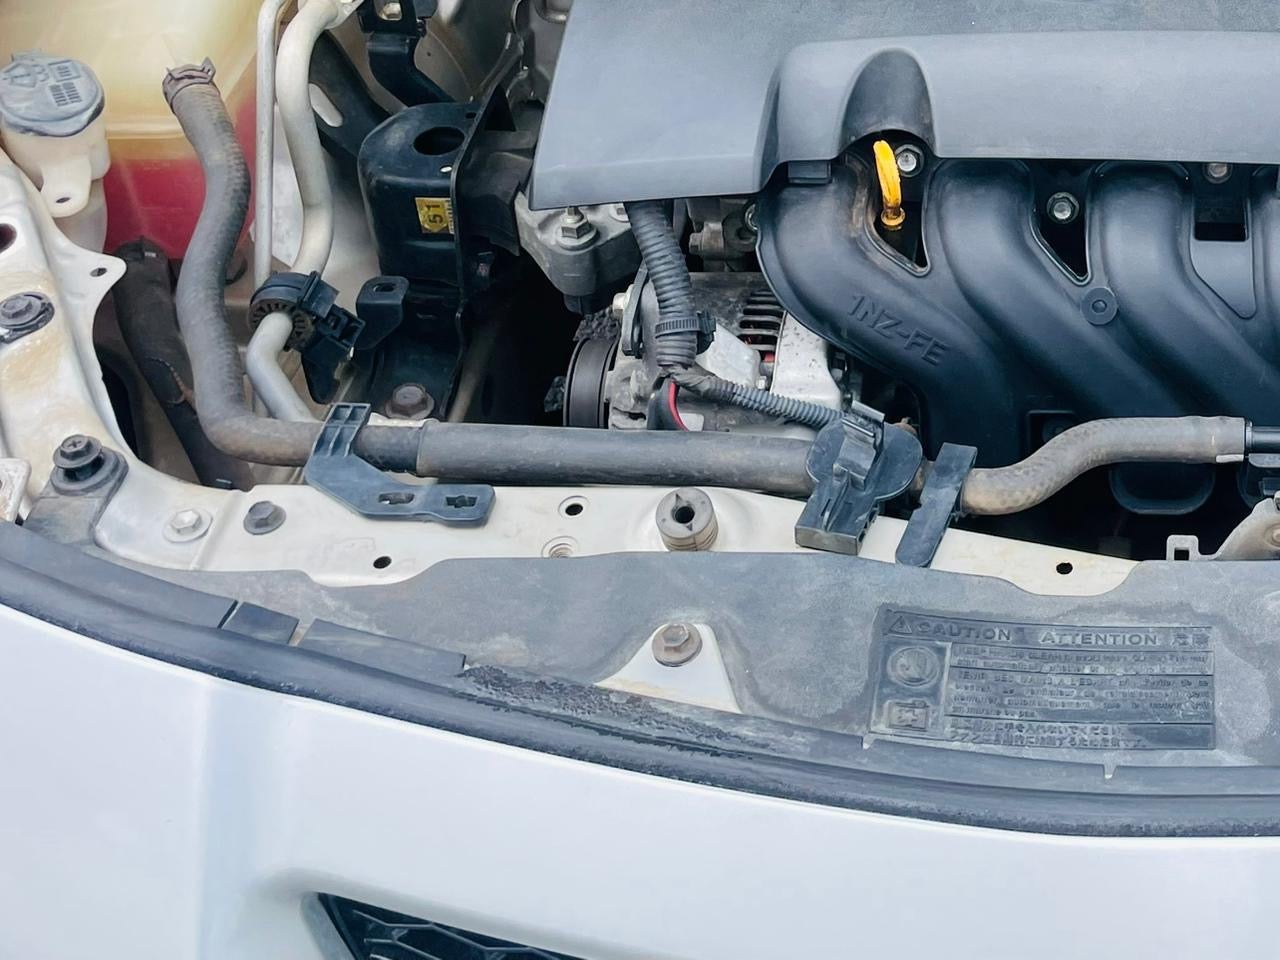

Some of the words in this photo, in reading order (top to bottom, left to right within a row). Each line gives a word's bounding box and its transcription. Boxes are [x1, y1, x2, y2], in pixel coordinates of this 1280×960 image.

[848, 295, 951, 367] 1NZ-FE
[918, 621, 1011, 641] CAUTION
[1040, 630, 1159, 647] ATTENTION
